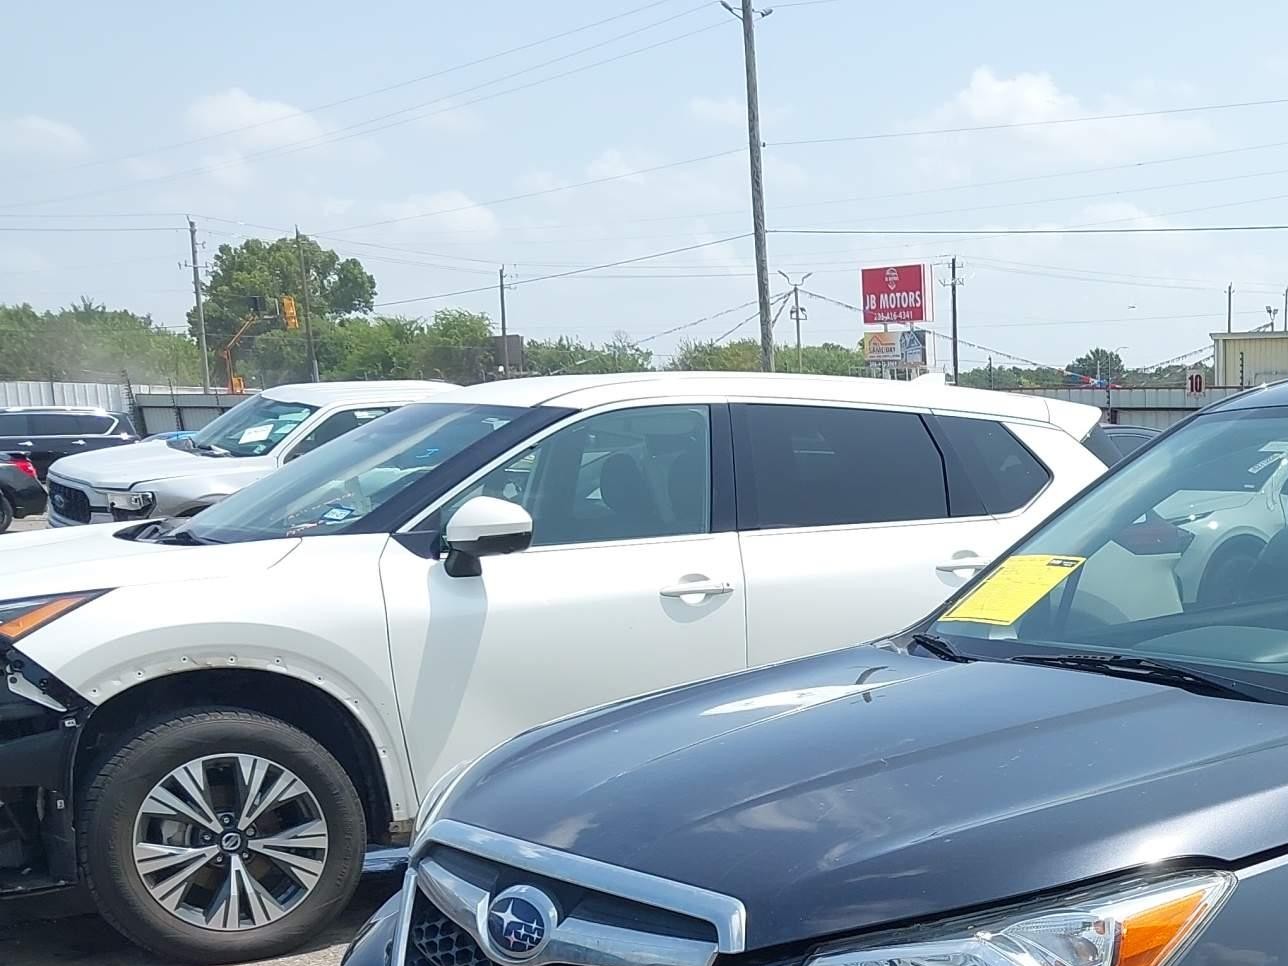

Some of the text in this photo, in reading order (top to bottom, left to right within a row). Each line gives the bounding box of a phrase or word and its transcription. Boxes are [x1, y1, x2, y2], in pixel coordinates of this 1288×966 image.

[865, 291, 921, 310] JB MOTORS
[1188, 374, 1203, 393] 10
